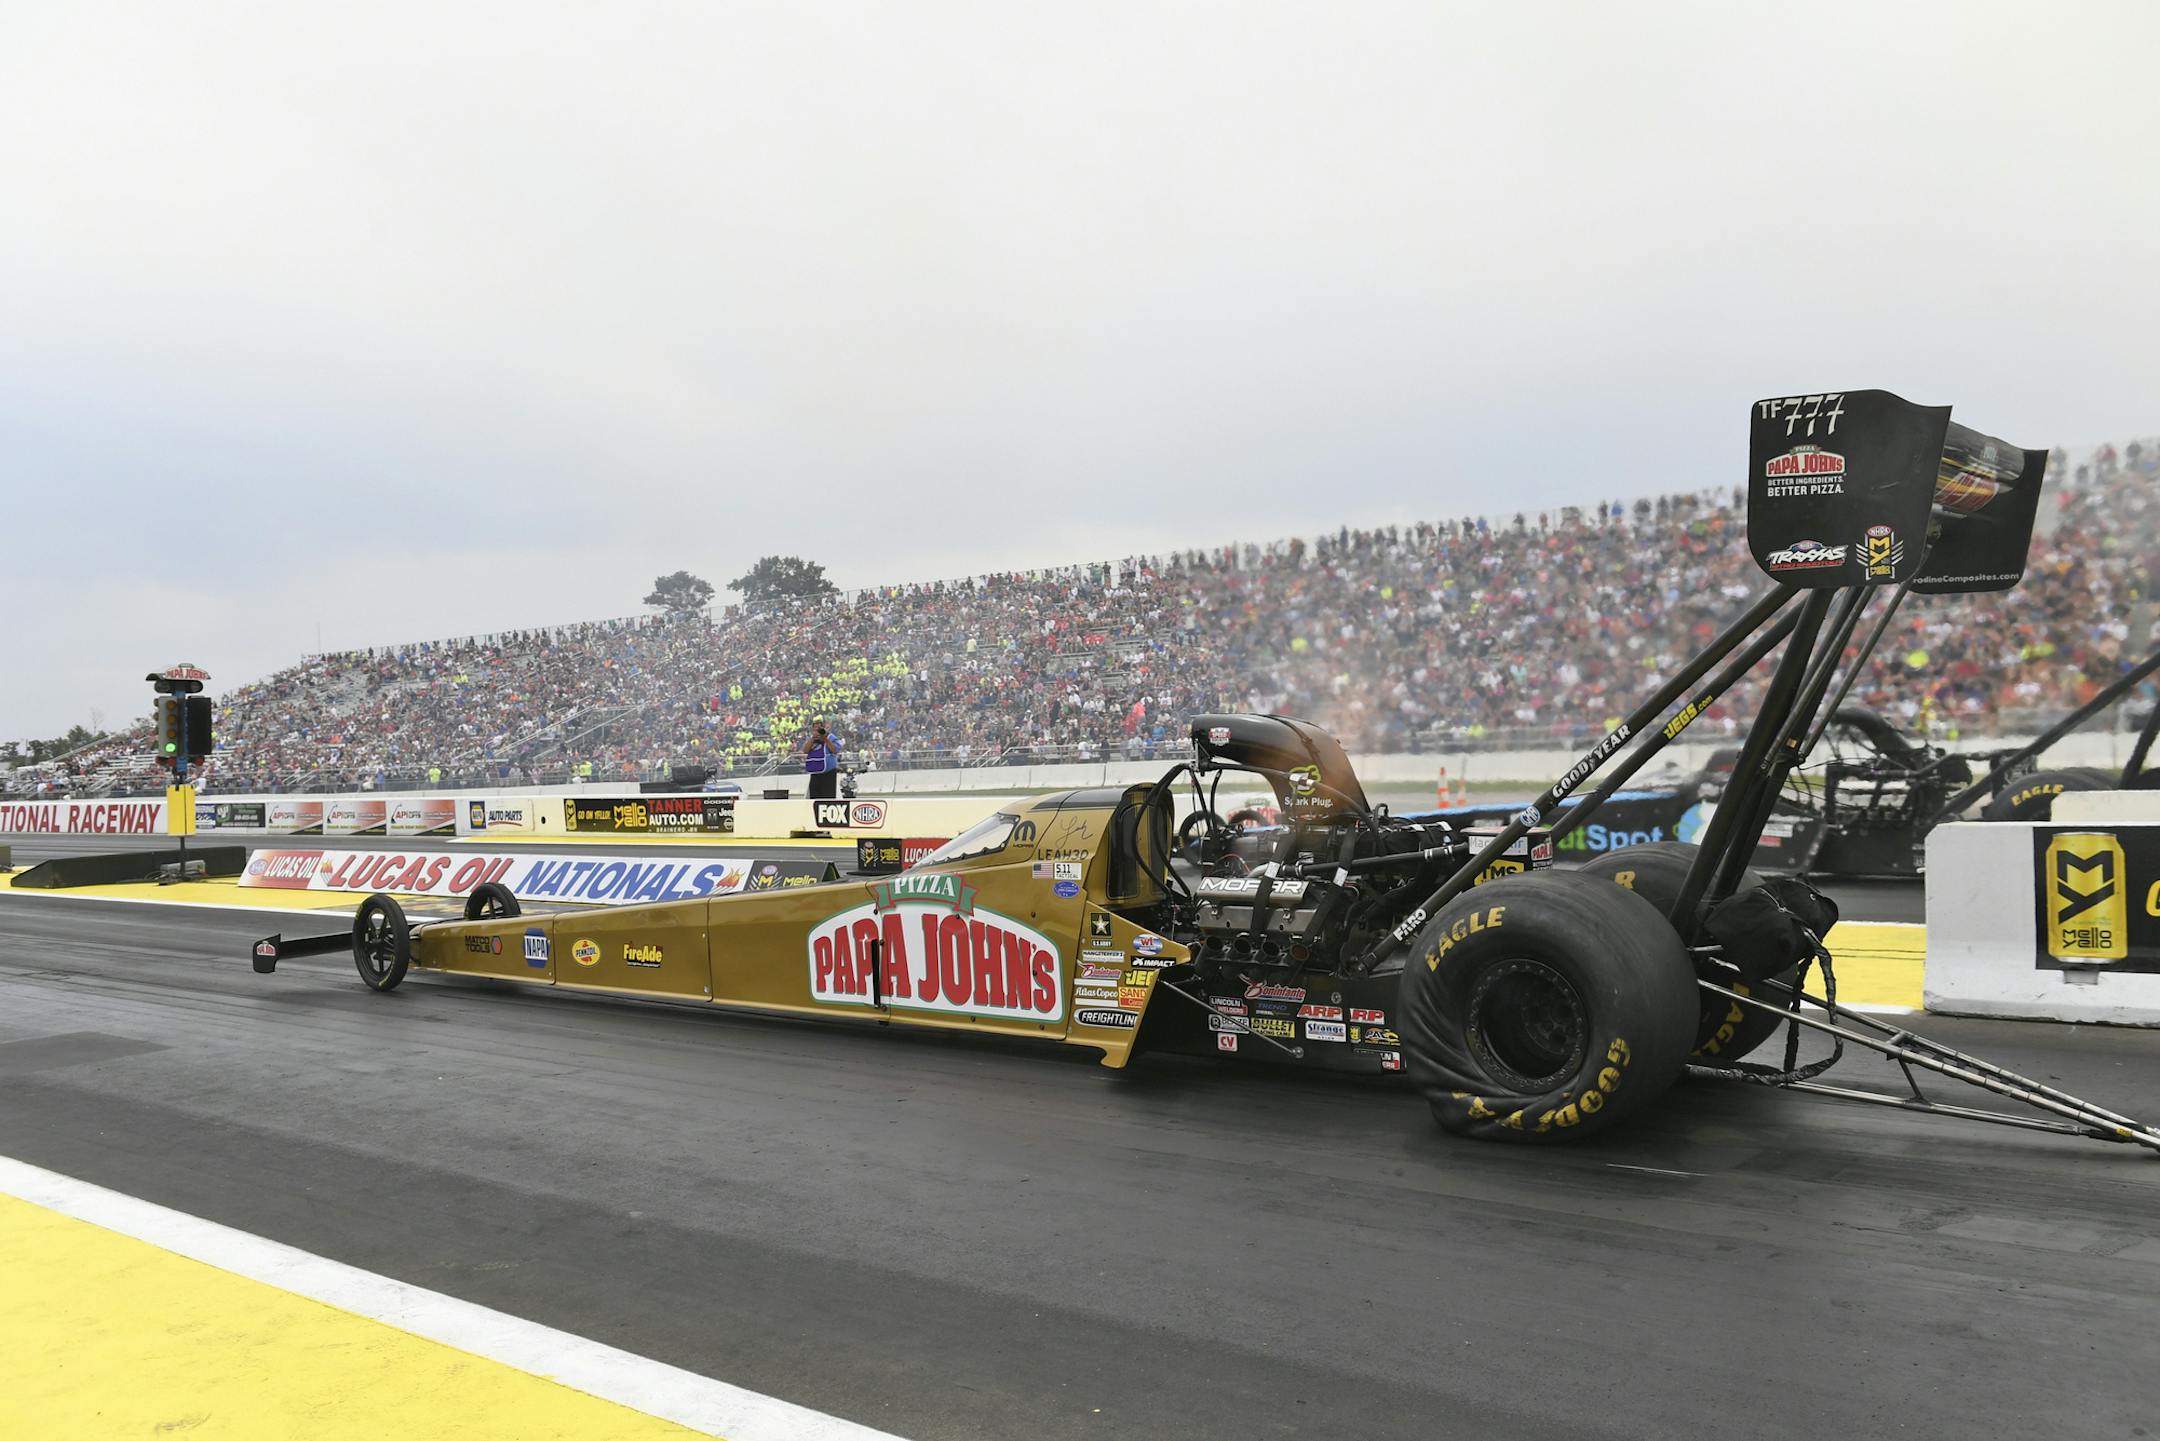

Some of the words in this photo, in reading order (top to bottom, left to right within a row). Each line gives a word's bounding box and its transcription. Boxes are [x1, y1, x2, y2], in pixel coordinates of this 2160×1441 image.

[1768, 456, 1800, 474] PAPA
[1767, 478, 1795, 486] BETTER
[1767, 486, 1808, 497] BETTER
[1810, 484, 1844, 494] PIZZA.
[1769, 546, 1847, 564] TRAXXAS
[1552, 724, 1631, 799] GOODYEAR
[2011, 783, 2064, 806] EAGLE
[648, 799, 704, 813] TANNER
[817, 804, 848, 824] FOX
[854, 805, 881, 822] NHRA
[67, 804, 161, 833] RACEWAY
[488, 810, 504, 821] AUTO
[505, 810, 522, 821] PARTS
[649, 814, 704, 826] AUTO.COM
[264, 855, 302, 877] LUCAS
[297, 856, 320, 878] OIL
[328, 854, 451, 892] LUCAS
[449, 857, 515, 893] OIL
[514, 859, 726, 900] NATIONALS
[894, 875, 956, 897] PIZZA
[1393, 908, 1427, 942] FARO
[464, 935, 490, 944] MATCO
[465, 943, 491, 953] TOOLS
[526, 937, 547, 958] NAPA
[1424, 906, 1506, 972] EAGLE
[623, 943, 663, 963] FireAde
[814, 913, 912, 998] PAPA
[918, 913, 1057, 1014] JOHN'S
[1144, 959, 1175, 967] IMPACT
[1075, 986, 1096, 997] Atlas
[1096, 987, 1119, 999] Copco
[1299, 1004, 1342, 1018] ARP
[1308, 1022, 1344, 1034] Strange
[1220, 1036, 1235, 1048] CV
